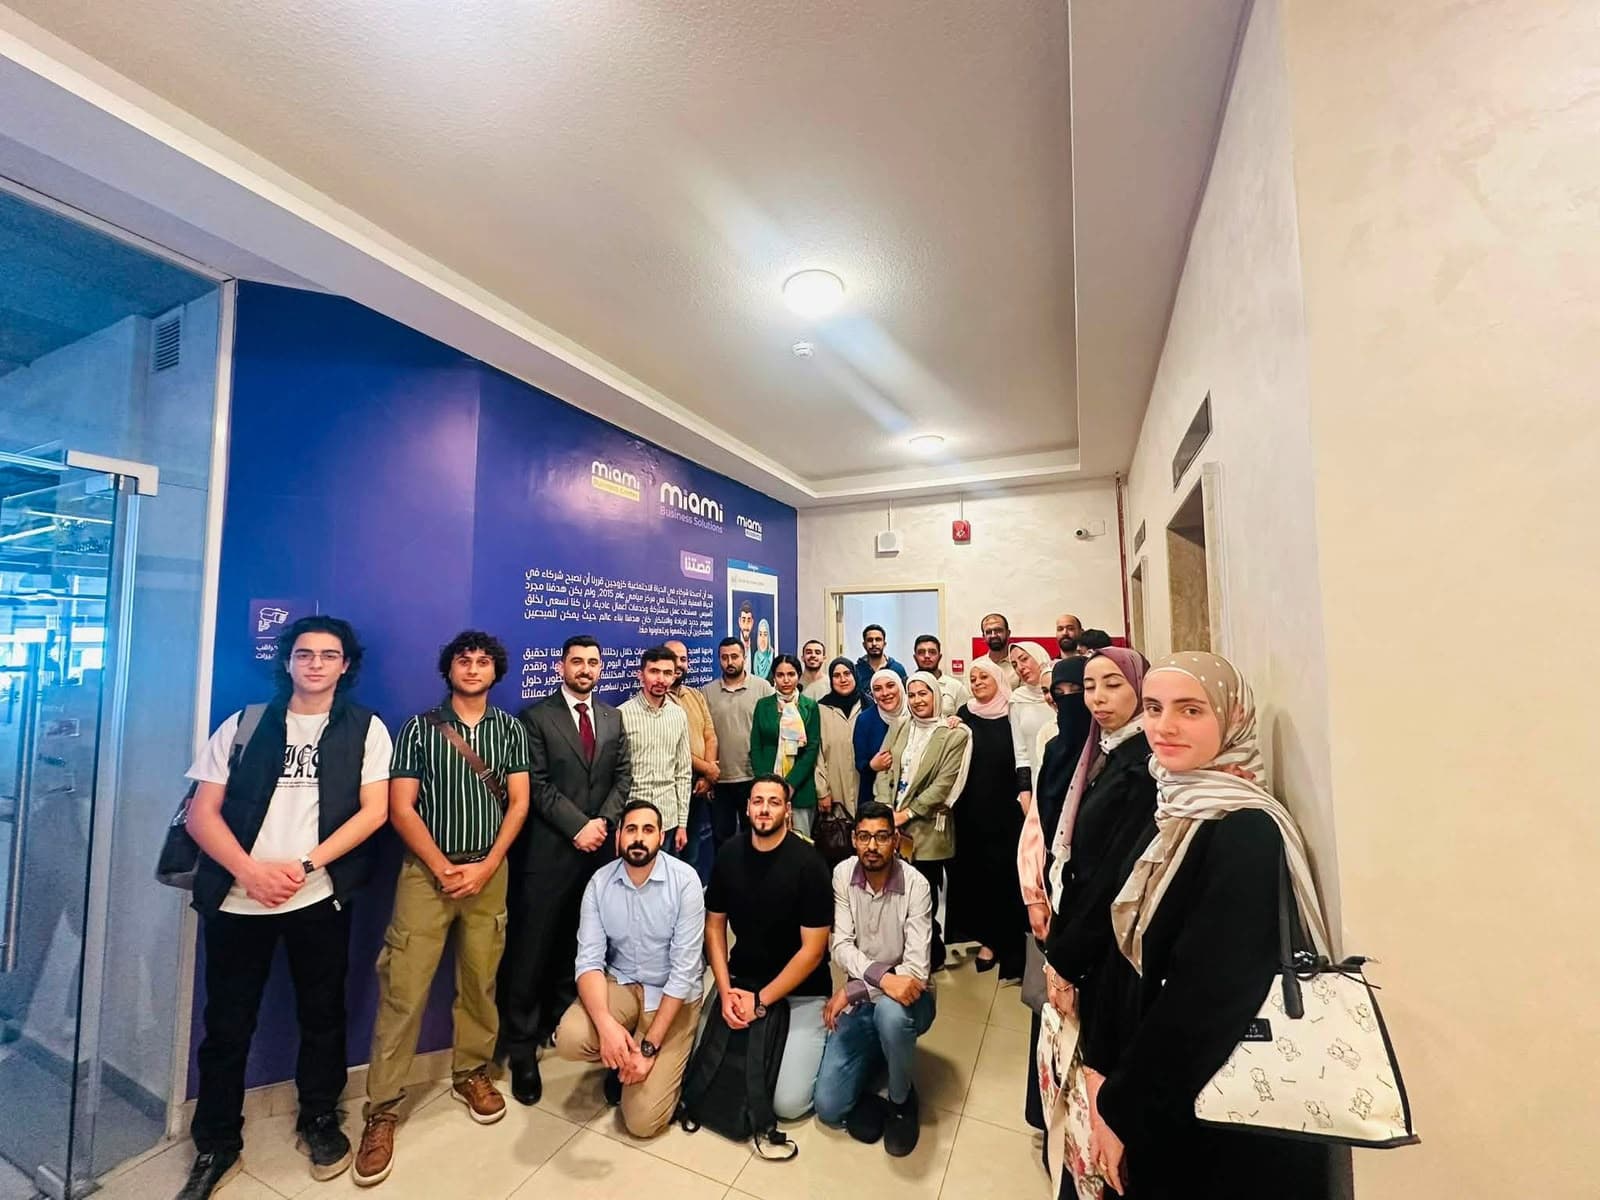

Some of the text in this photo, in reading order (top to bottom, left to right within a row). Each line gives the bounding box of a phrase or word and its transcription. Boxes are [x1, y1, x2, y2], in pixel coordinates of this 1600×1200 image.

[591, 461, 640, 490] miami
[660, 482, 724, 523] miami
[660, 505, 724, 534] Business Solutions
[736, 515, 762, 533] miami
[684, 556, 711, 575] قصتنا
[525, 567, 540, 580] في
[542, 568, 564, 581] شركاء
[564, 573, 582, 584] نصبح
[582, 572, 590, 586] أن
[525, 582, 544, 592] مجرد
[546, 582, 567, 593] هدفنا
[568, 586, 582, 597] يكن
[584, 586, 596, 598] ولم
[524, 594, 544, 606] لخلق
[546, 598, 568, 608] نسعى
[570, 598, 580, 607] كنا
[582, 599, 591, 610] بل
[524, 608, 558, 620] للمبدعين
[560, 609, 580, 622] يمكن
[582, 610, 596, 622] حيث
[523, 648, 548, 660] تحقيق
[522, 675, 542, 688] حلول
